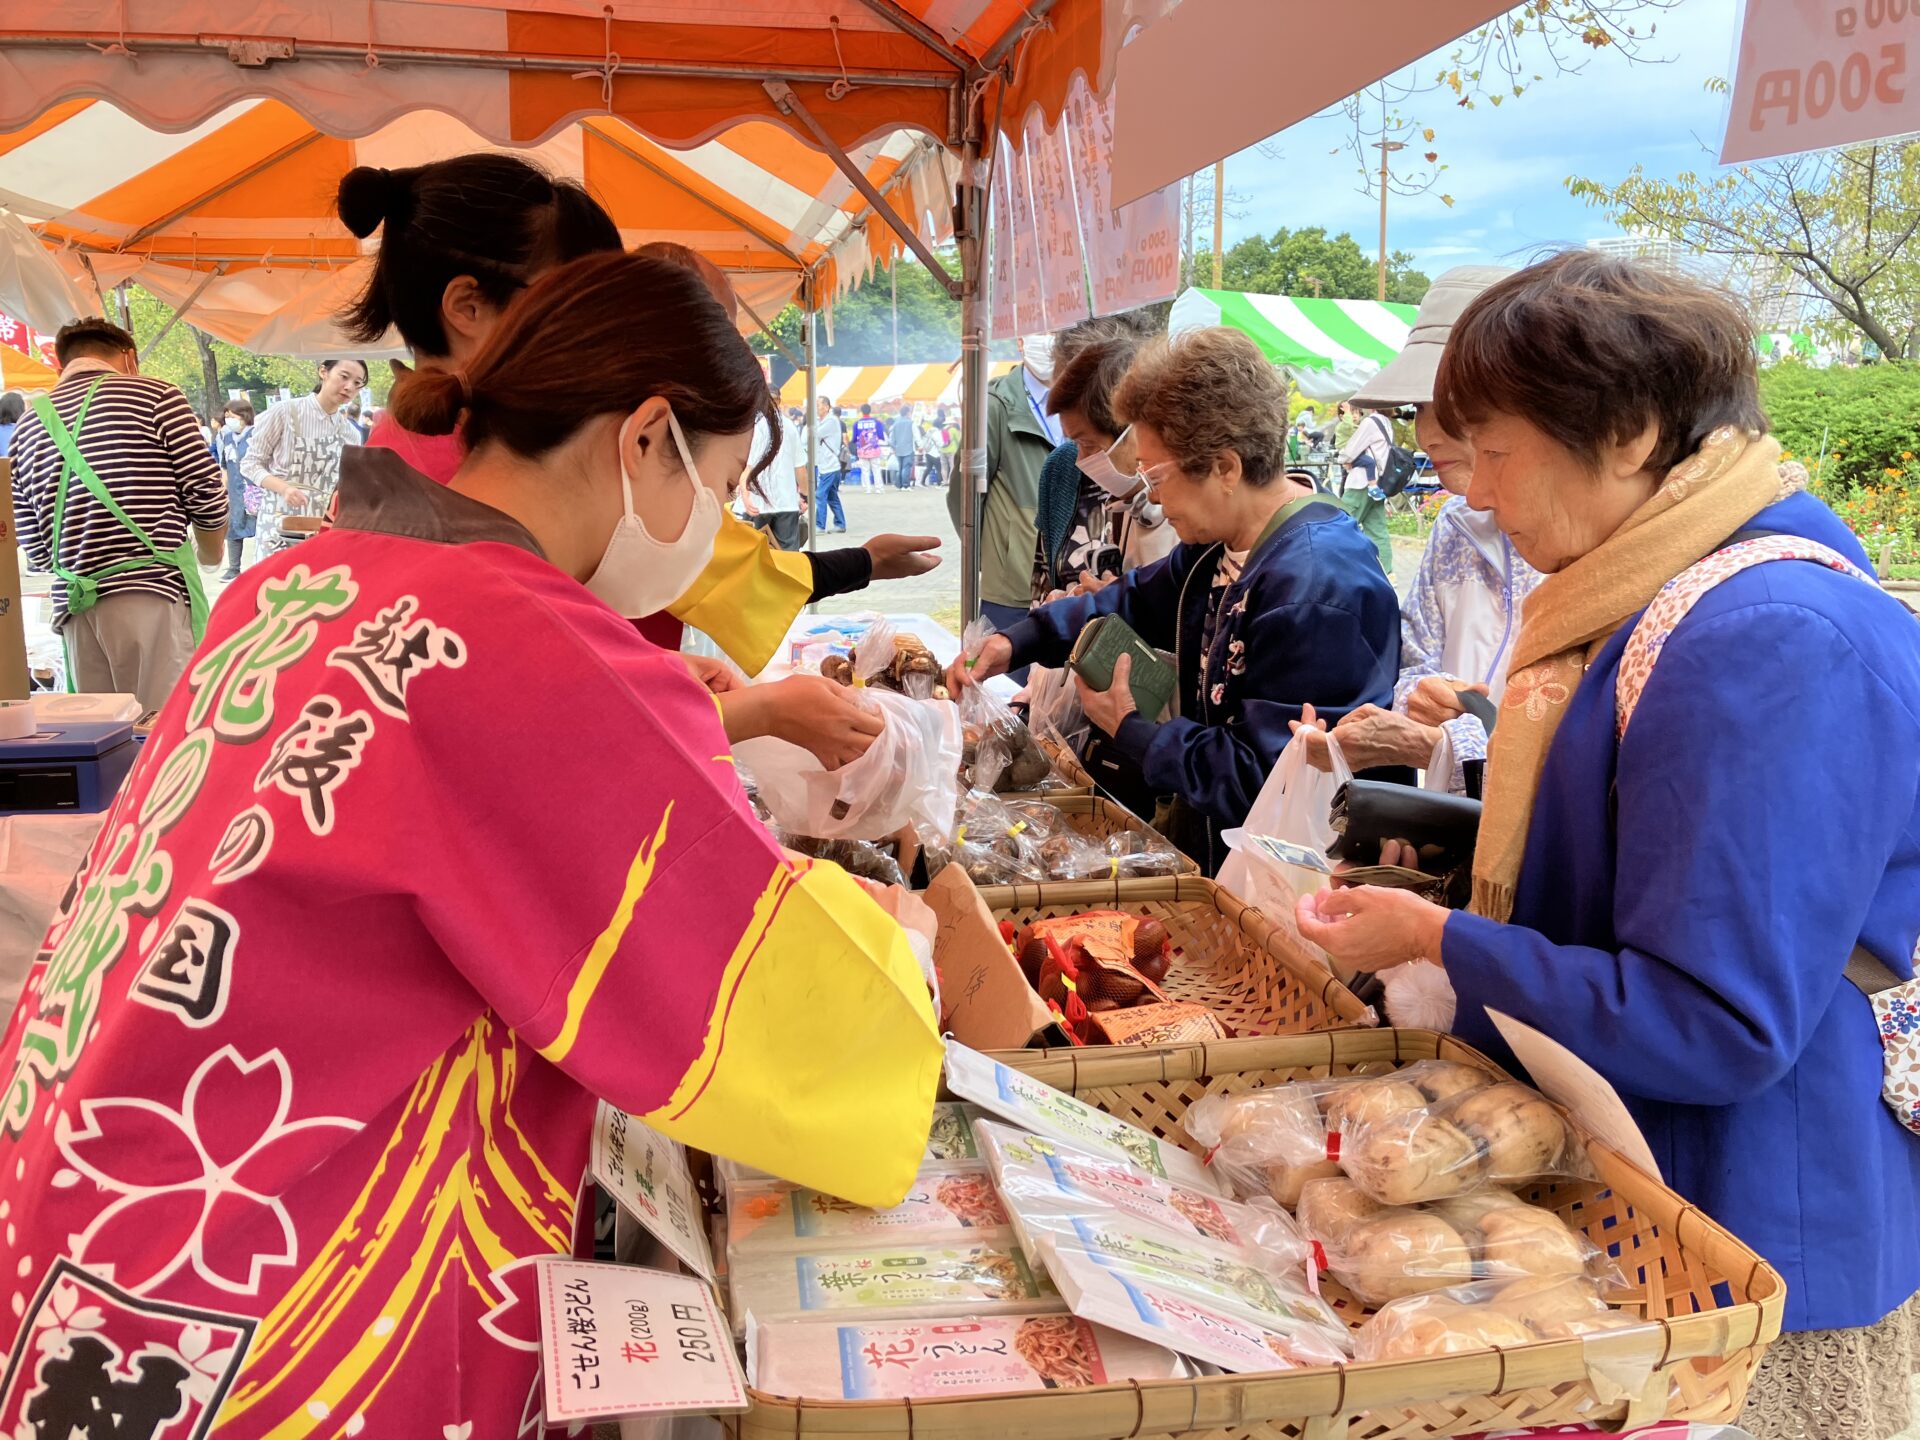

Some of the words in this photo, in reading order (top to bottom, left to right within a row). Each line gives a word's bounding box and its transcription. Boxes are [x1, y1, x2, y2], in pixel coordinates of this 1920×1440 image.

[131, 596, 467, 1028] 越後の国
[564, 1278, 600, 1390] ごせん桜うどん
[671, 1303, 716, 1364] 250円
[863, 1337, 1009, 1370] 花うどん
